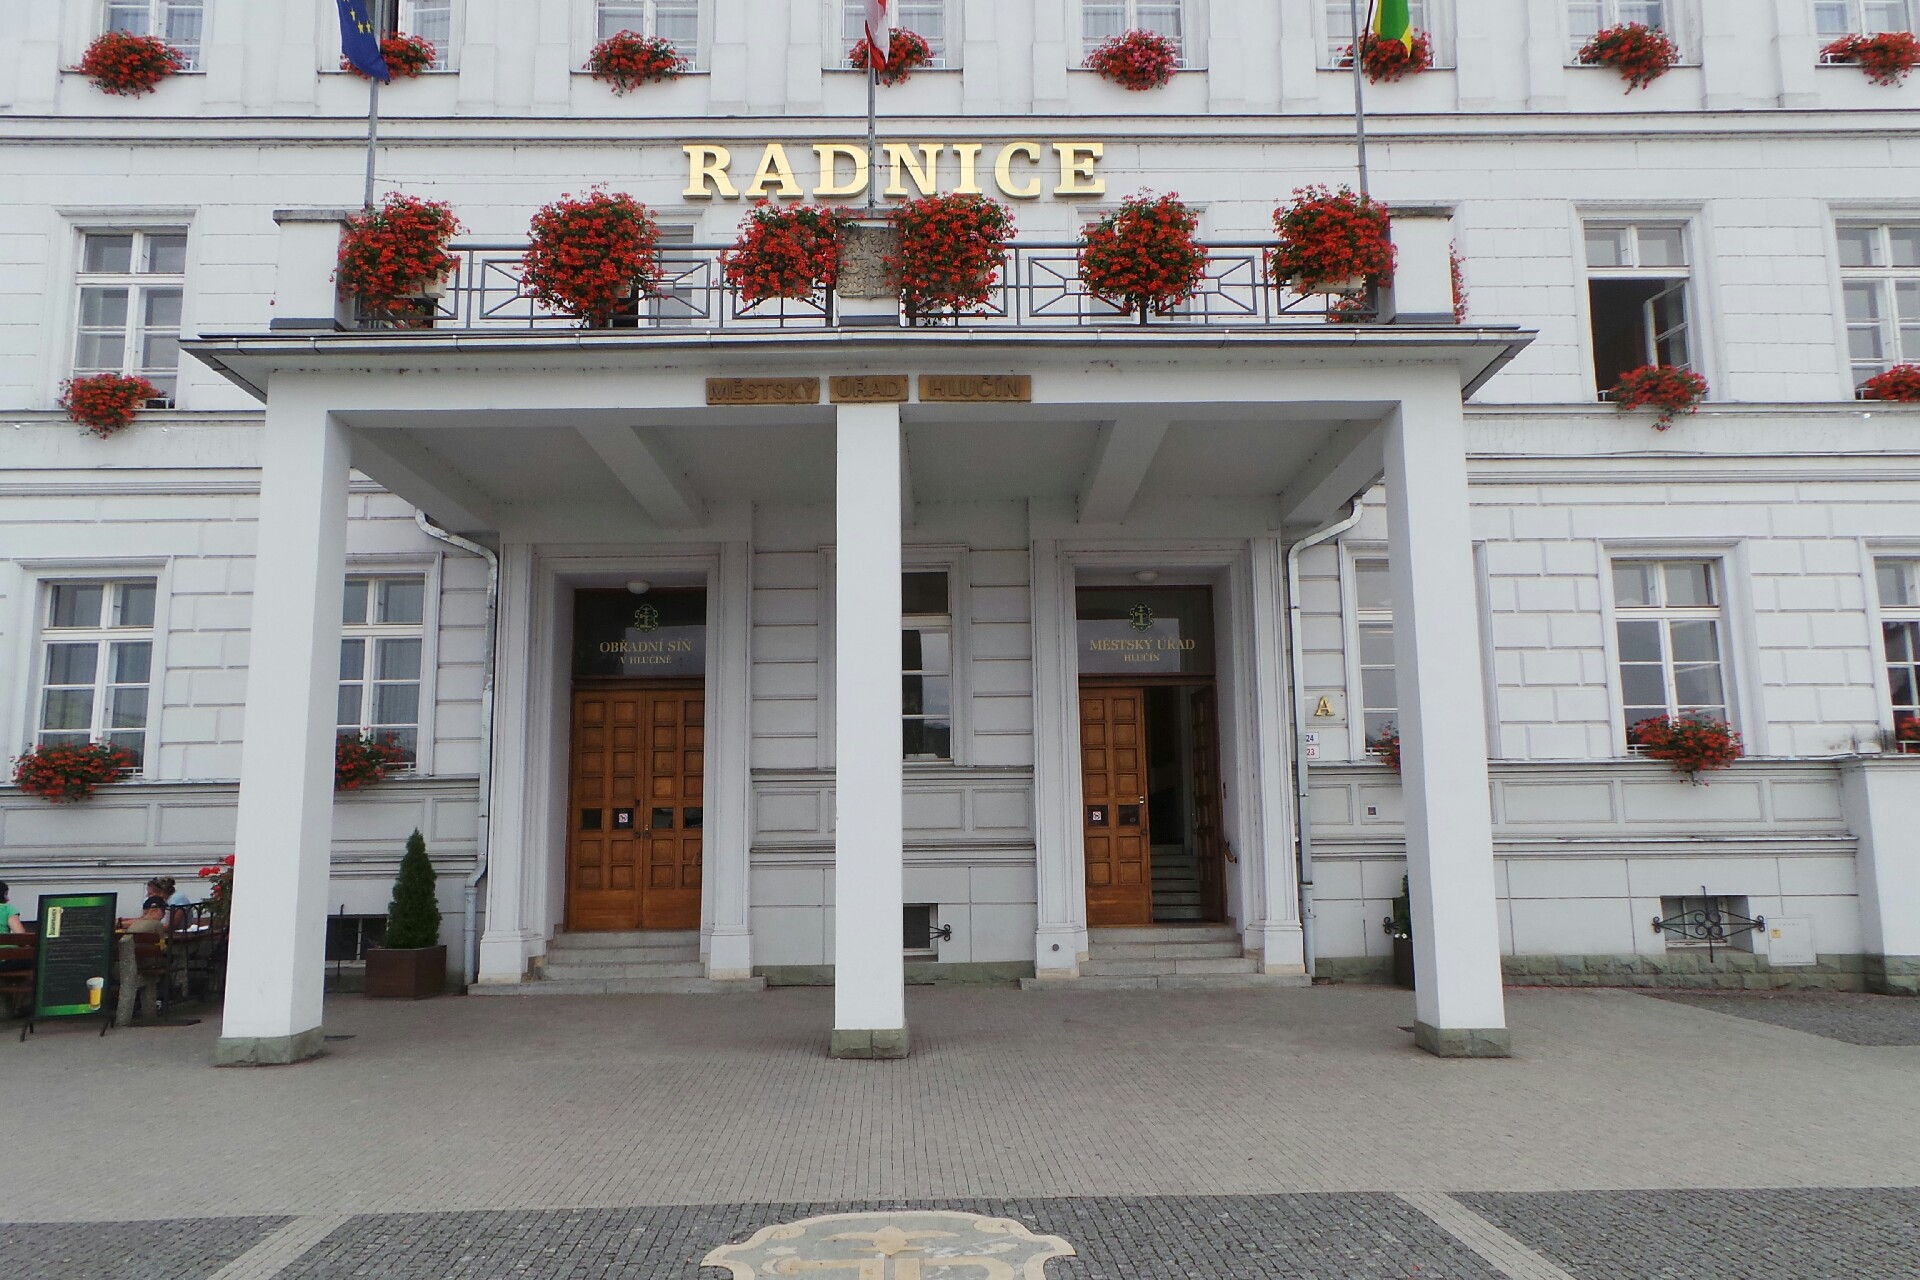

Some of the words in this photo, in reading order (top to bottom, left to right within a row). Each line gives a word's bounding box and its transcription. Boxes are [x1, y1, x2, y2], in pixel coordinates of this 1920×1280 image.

[682, 141, 1106, 200] RADNICE
[708, 378, 817, 400] MĚSTSKÝ
[837, 375, 902, 399] ÚŘAD
[928, 376, 1021, 398] HLUČÍN
[600, 638, 664, 653] OBŘADNÍ
[668, 638, 691, 652] SÍŇ
[1090, 636, 1152, 651] MĚSTSKÝ
[1157, 636, 1195, 650] ÚŘAD
[620, 656, 626, 664] V
[1124, 652, 1160, 662] HLUČÍN
[1314, 695, 1336, 717] A
